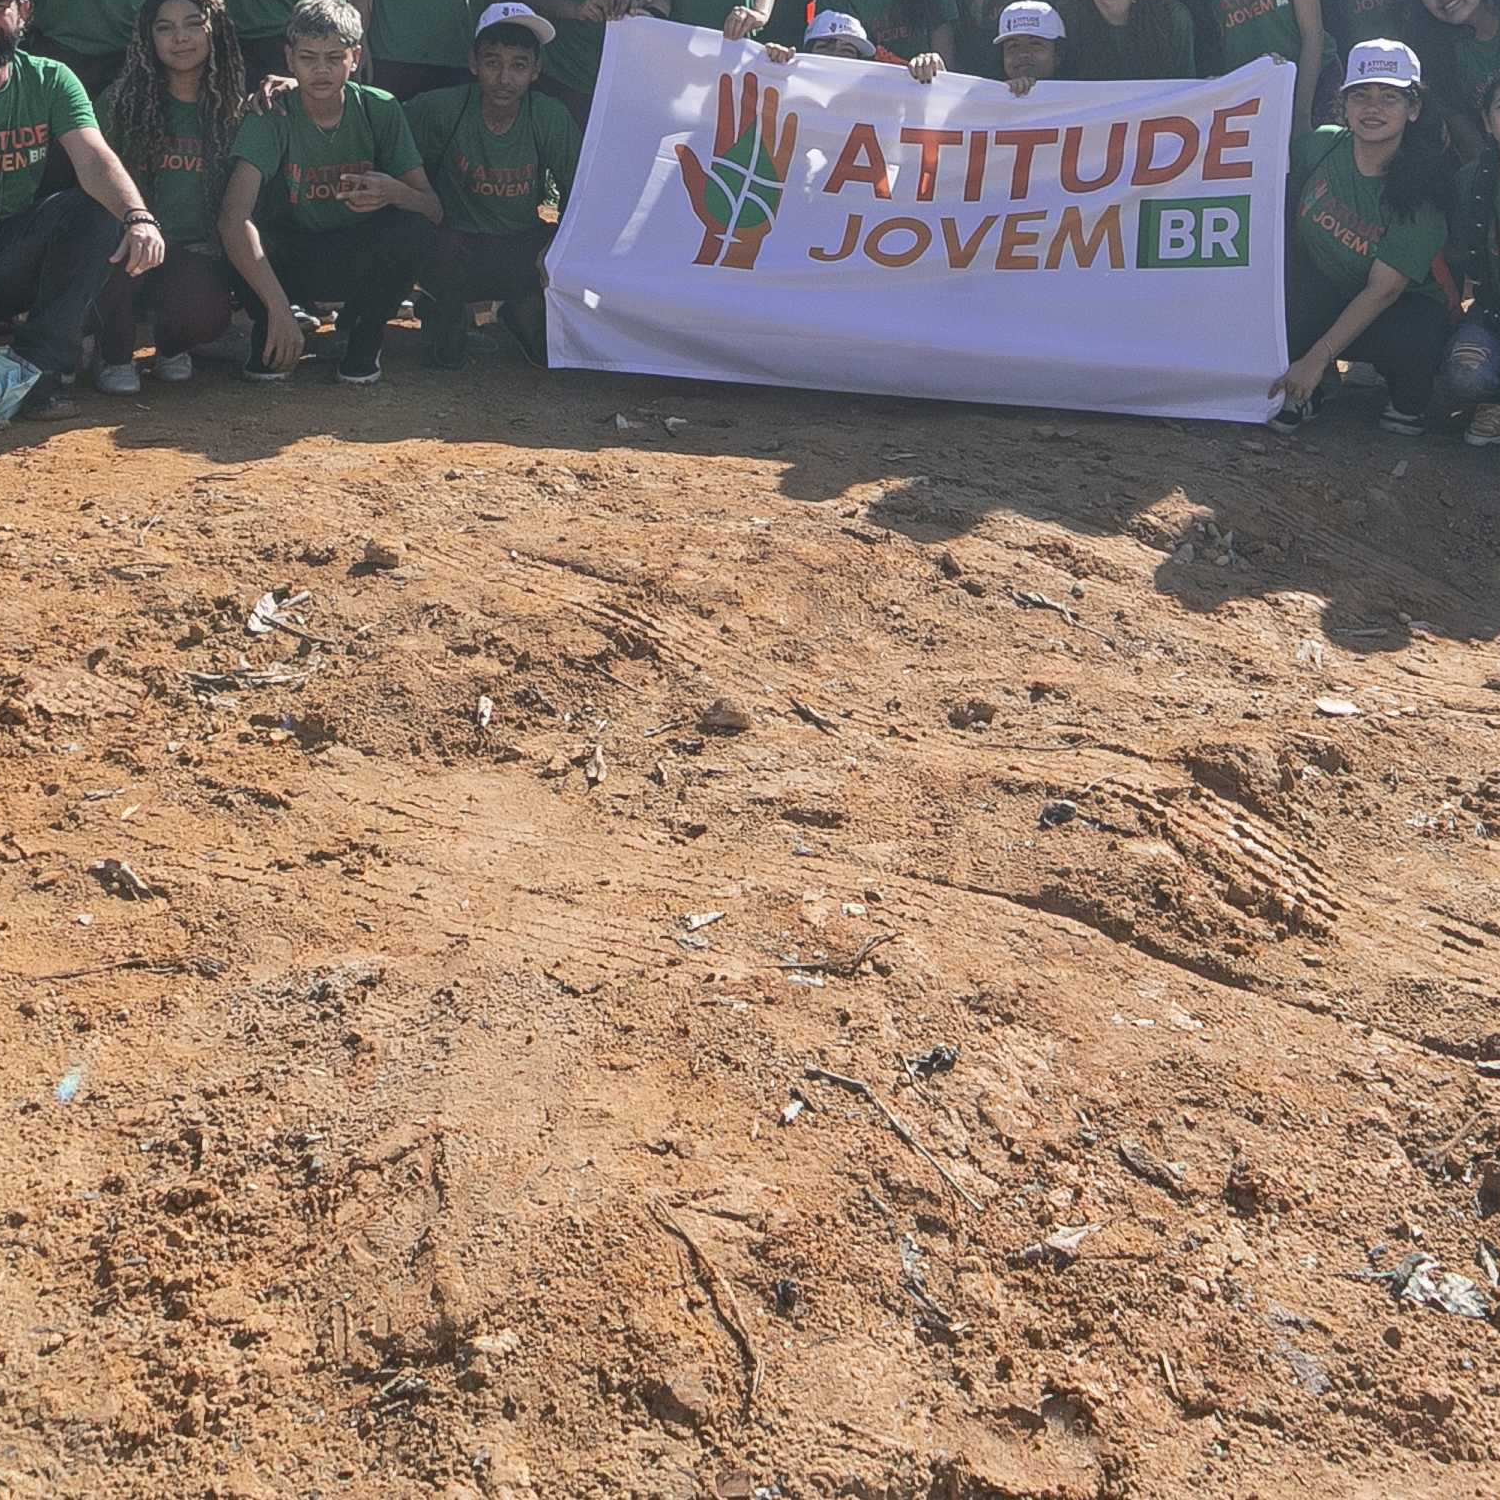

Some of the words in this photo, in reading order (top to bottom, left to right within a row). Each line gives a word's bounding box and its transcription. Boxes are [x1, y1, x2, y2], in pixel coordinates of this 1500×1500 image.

[160, 153, 204, 173] JOVE
[822, 97, 1261, 203] ATITUDE
[471, 180, 530, 198] JOVEM
[808, 204, 1126, 270] JOVEM
[1158, 207, 1241, 261] BR
[1311, 210, 1369, 256] JOVEM
